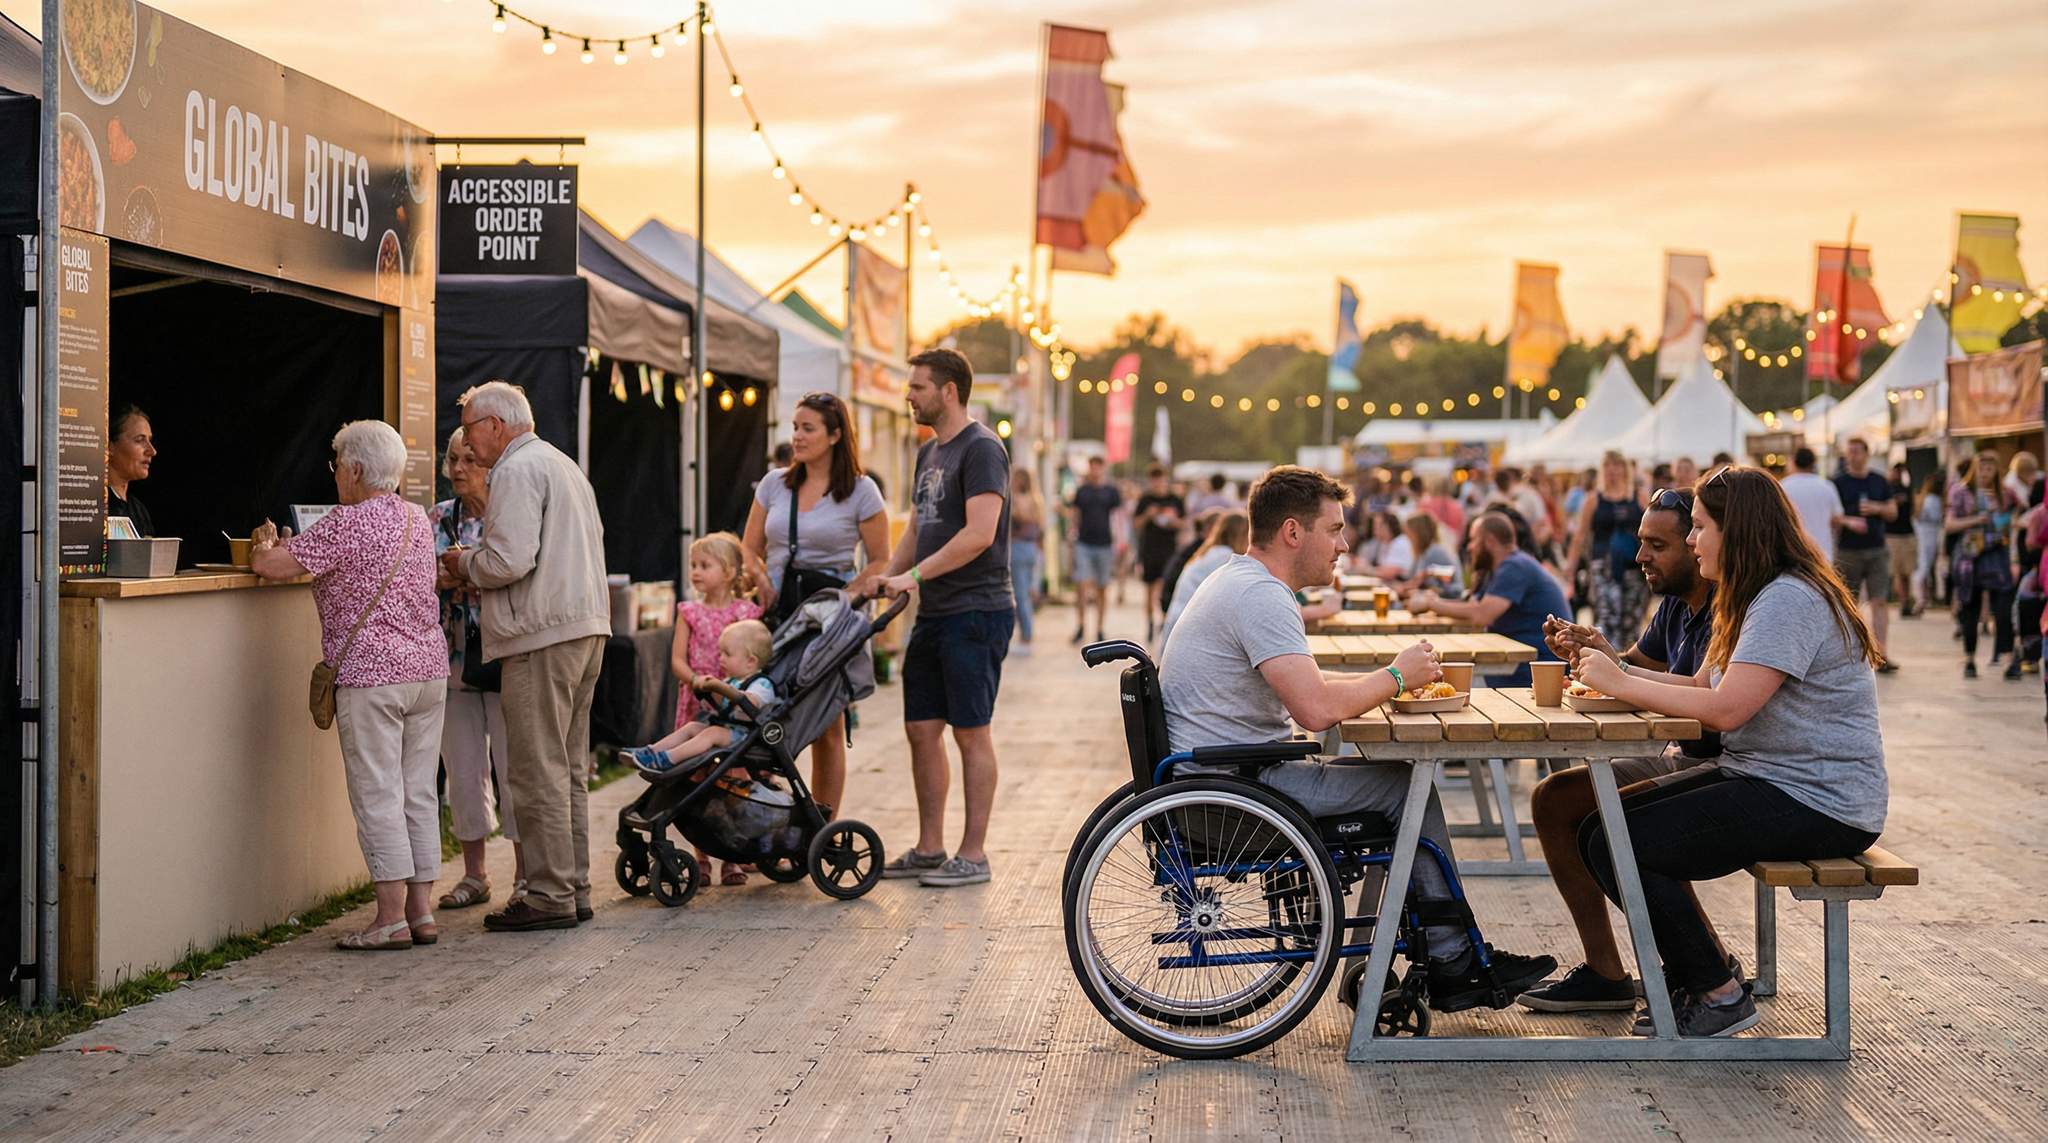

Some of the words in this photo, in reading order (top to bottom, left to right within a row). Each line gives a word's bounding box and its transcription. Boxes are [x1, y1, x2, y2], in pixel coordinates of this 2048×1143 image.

[185, 89, 295, 219] GLOBAL
[303, 134, 370, 242] BITES
[447, 178, 571, 204] ACCESSIBLE
[475, 206, 543, 232] ORDER
[62, 245, 92, 271] GLOBAL
[478, 235, 541, 261] POINT
[65, 269, 89, 294] BITES
